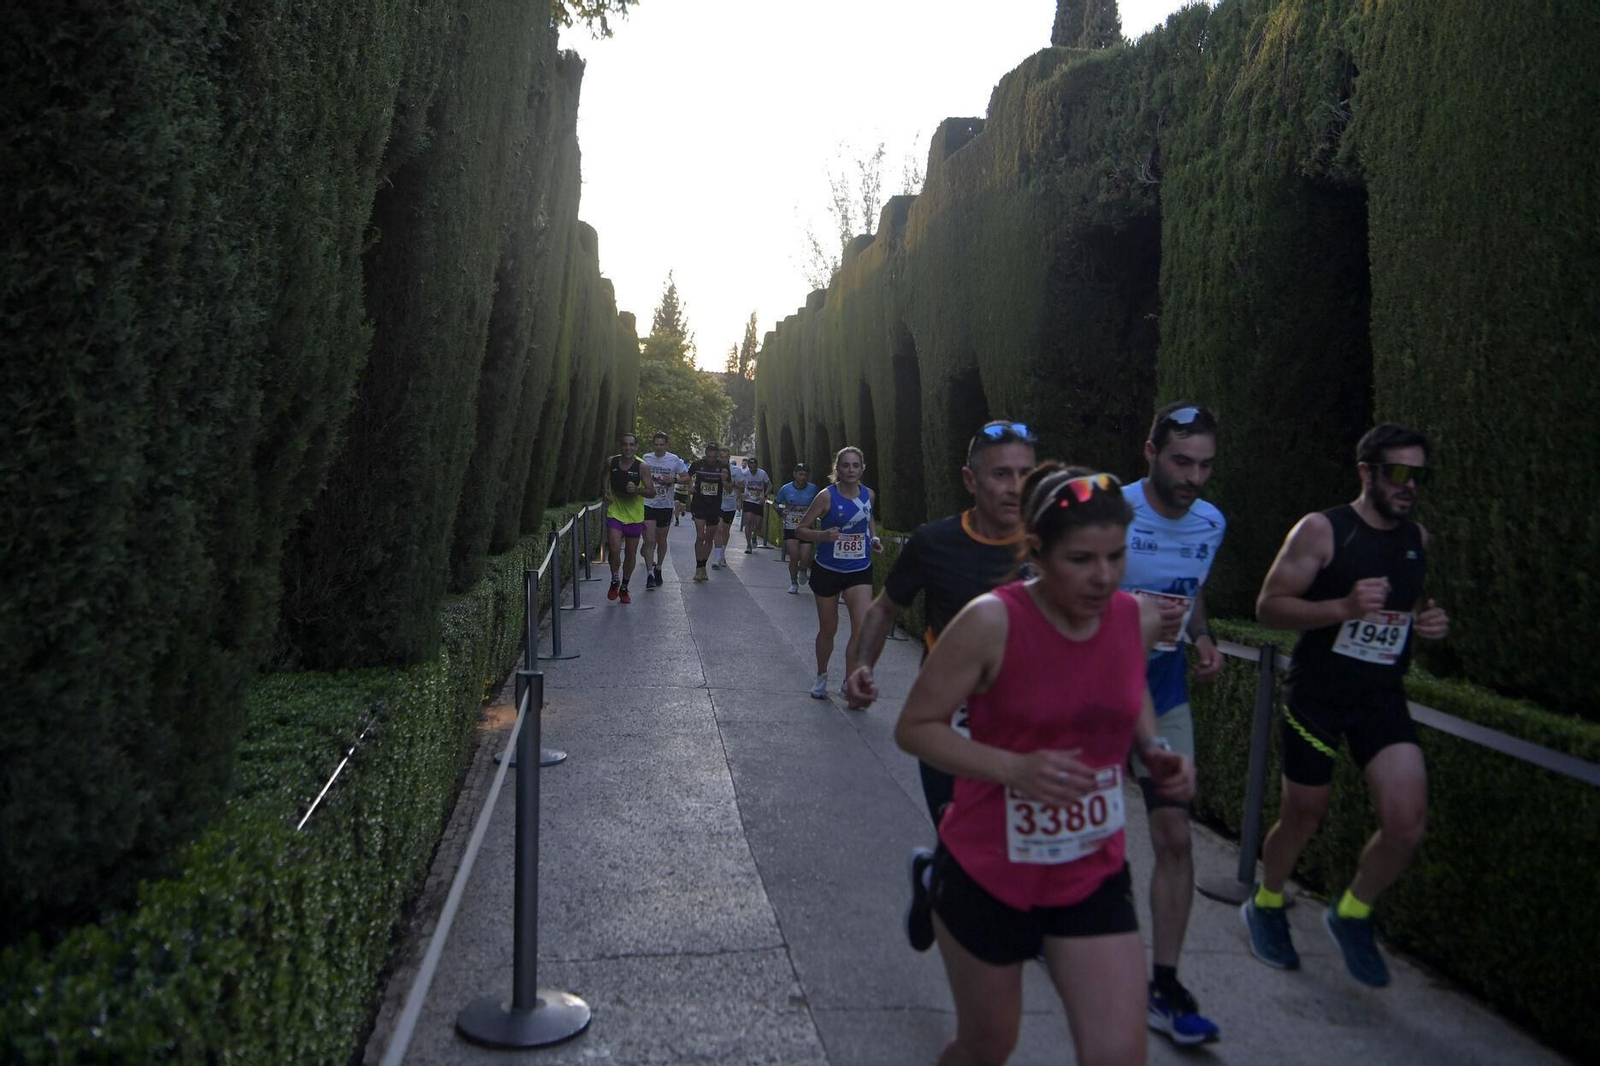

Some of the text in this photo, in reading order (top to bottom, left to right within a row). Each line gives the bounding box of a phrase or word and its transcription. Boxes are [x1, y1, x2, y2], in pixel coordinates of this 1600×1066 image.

[836, 540, 863, 552] 1683
[1347, 620, 1400, 647] 1949
[1013, 794, 1108, 836] 3380
